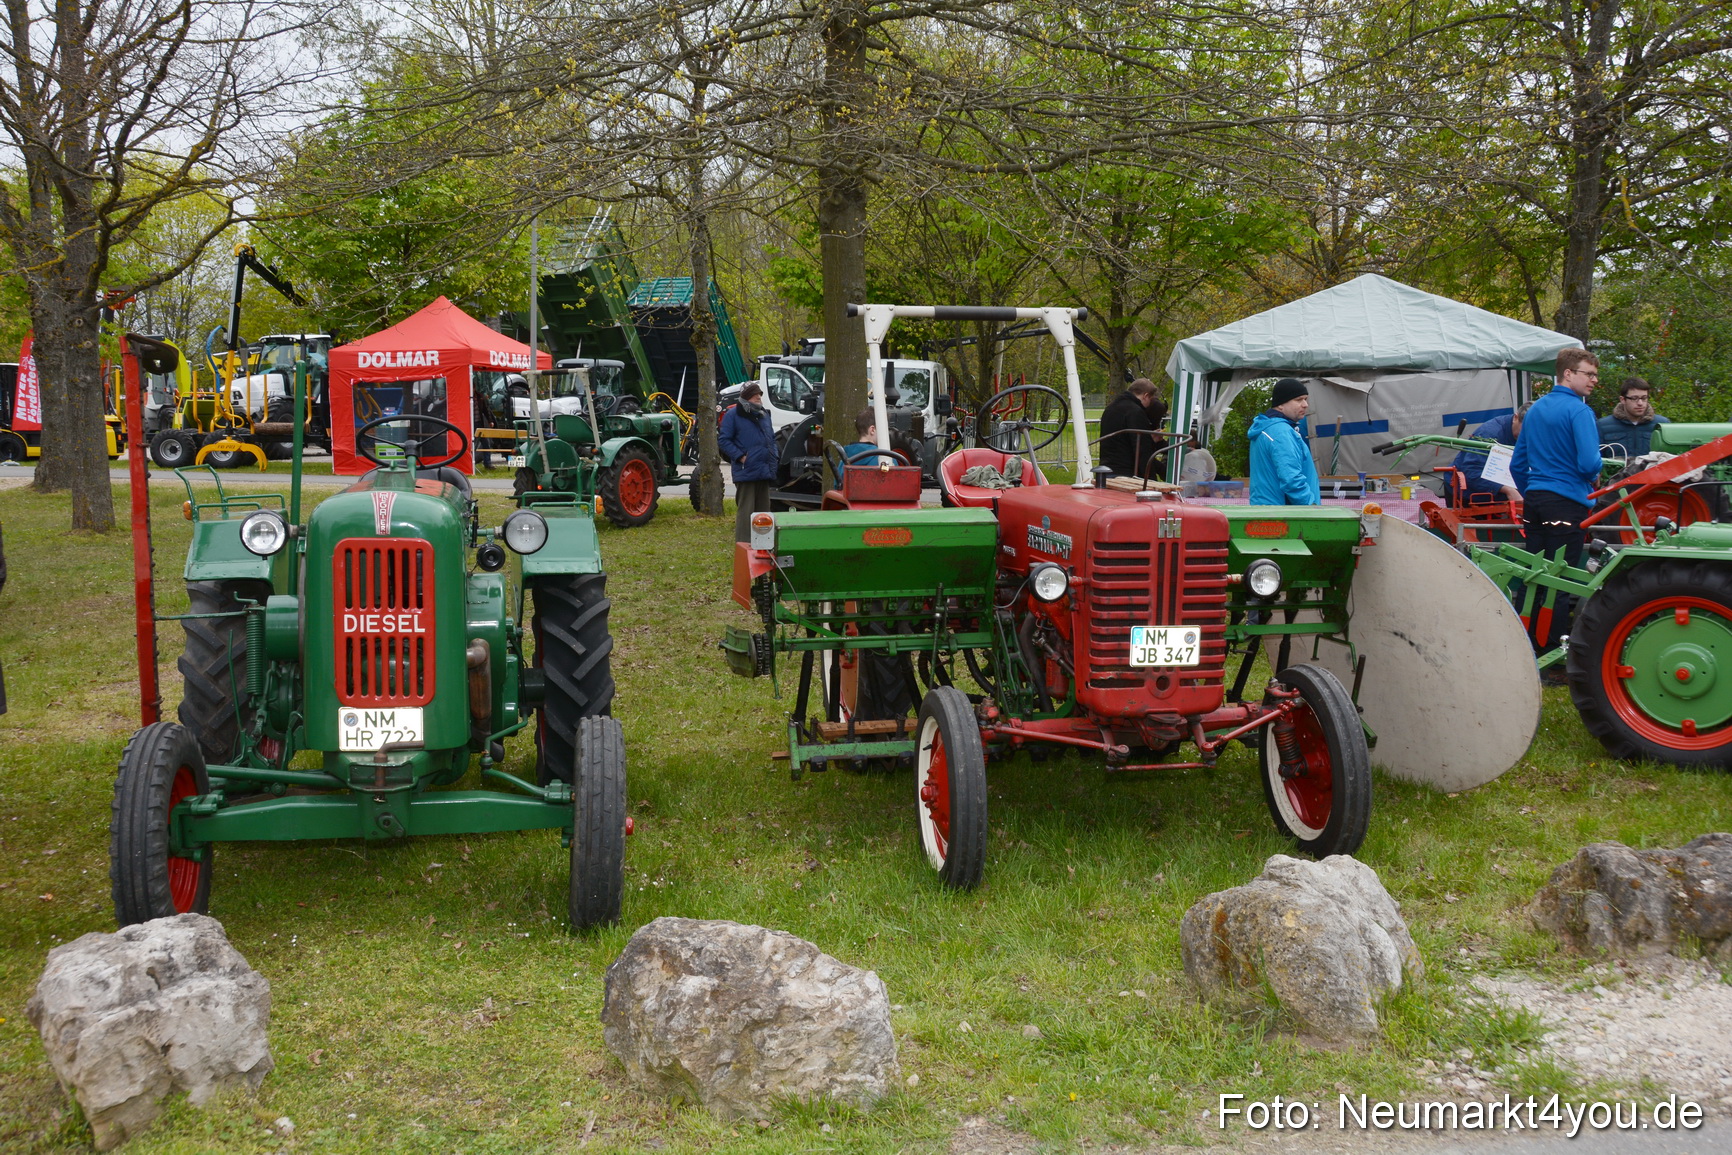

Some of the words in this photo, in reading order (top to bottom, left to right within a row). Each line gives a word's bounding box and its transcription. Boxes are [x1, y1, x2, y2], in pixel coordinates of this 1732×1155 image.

[358, 350, 439, 368] DOLMAR
[16, 373, 27, 420] MEYER
[343, 614, 426, 633] DIESEL
[1145, 629, 1167, 645] NM
[1136, 647, 1158, 663] JB
[1164, 647, 1194, 663] 347
[364, 711, 395, 728] NM
[345, 730, 373, 747] HR
